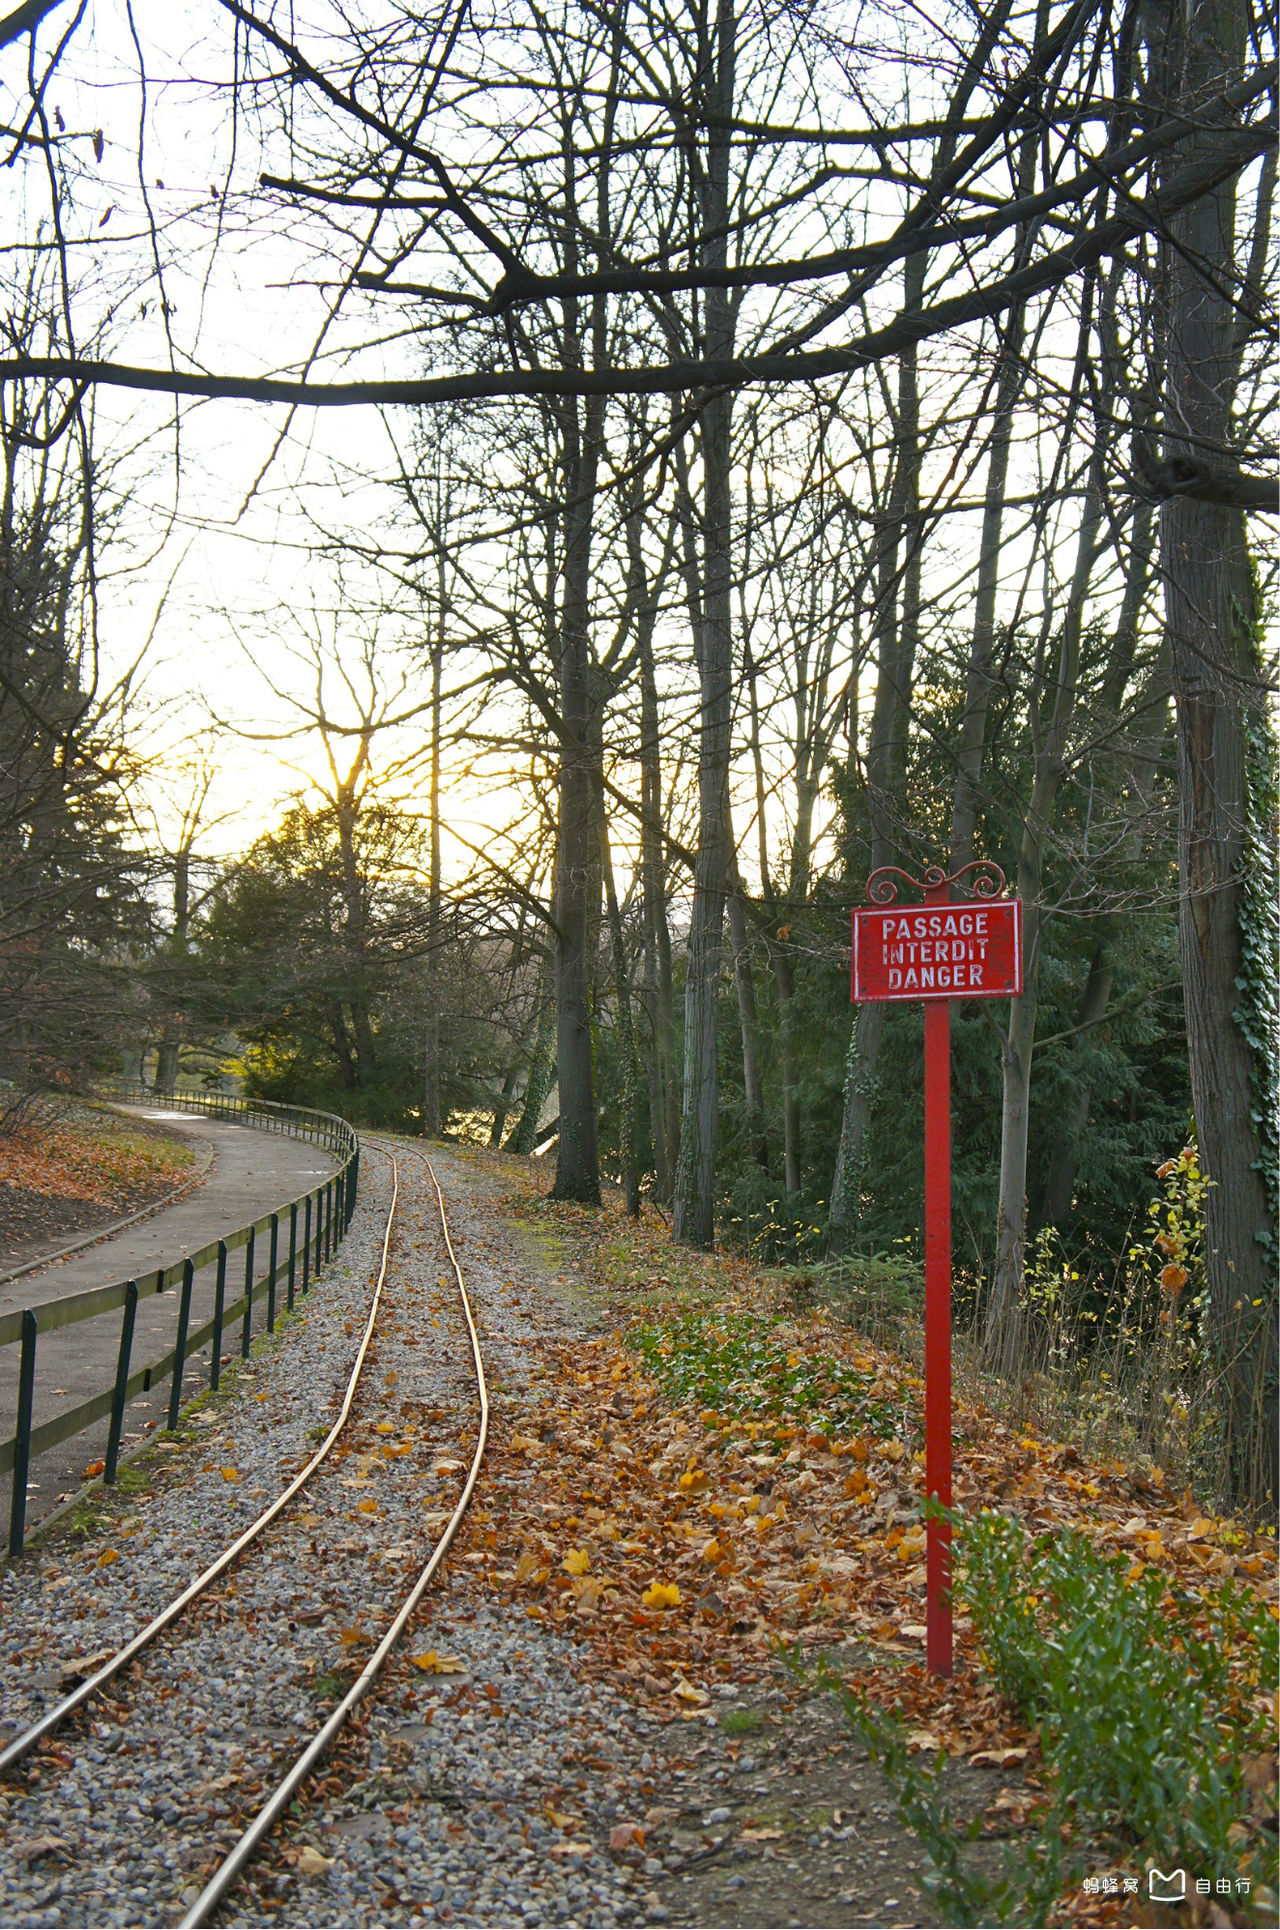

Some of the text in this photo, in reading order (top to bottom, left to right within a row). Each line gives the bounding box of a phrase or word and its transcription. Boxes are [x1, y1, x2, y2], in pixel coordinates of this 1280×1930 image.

[882, 913, 988, 940] PASSAGE
[882, 938, 989, 965] INTERDIT
[888, 964, 983, 989] DANGER
